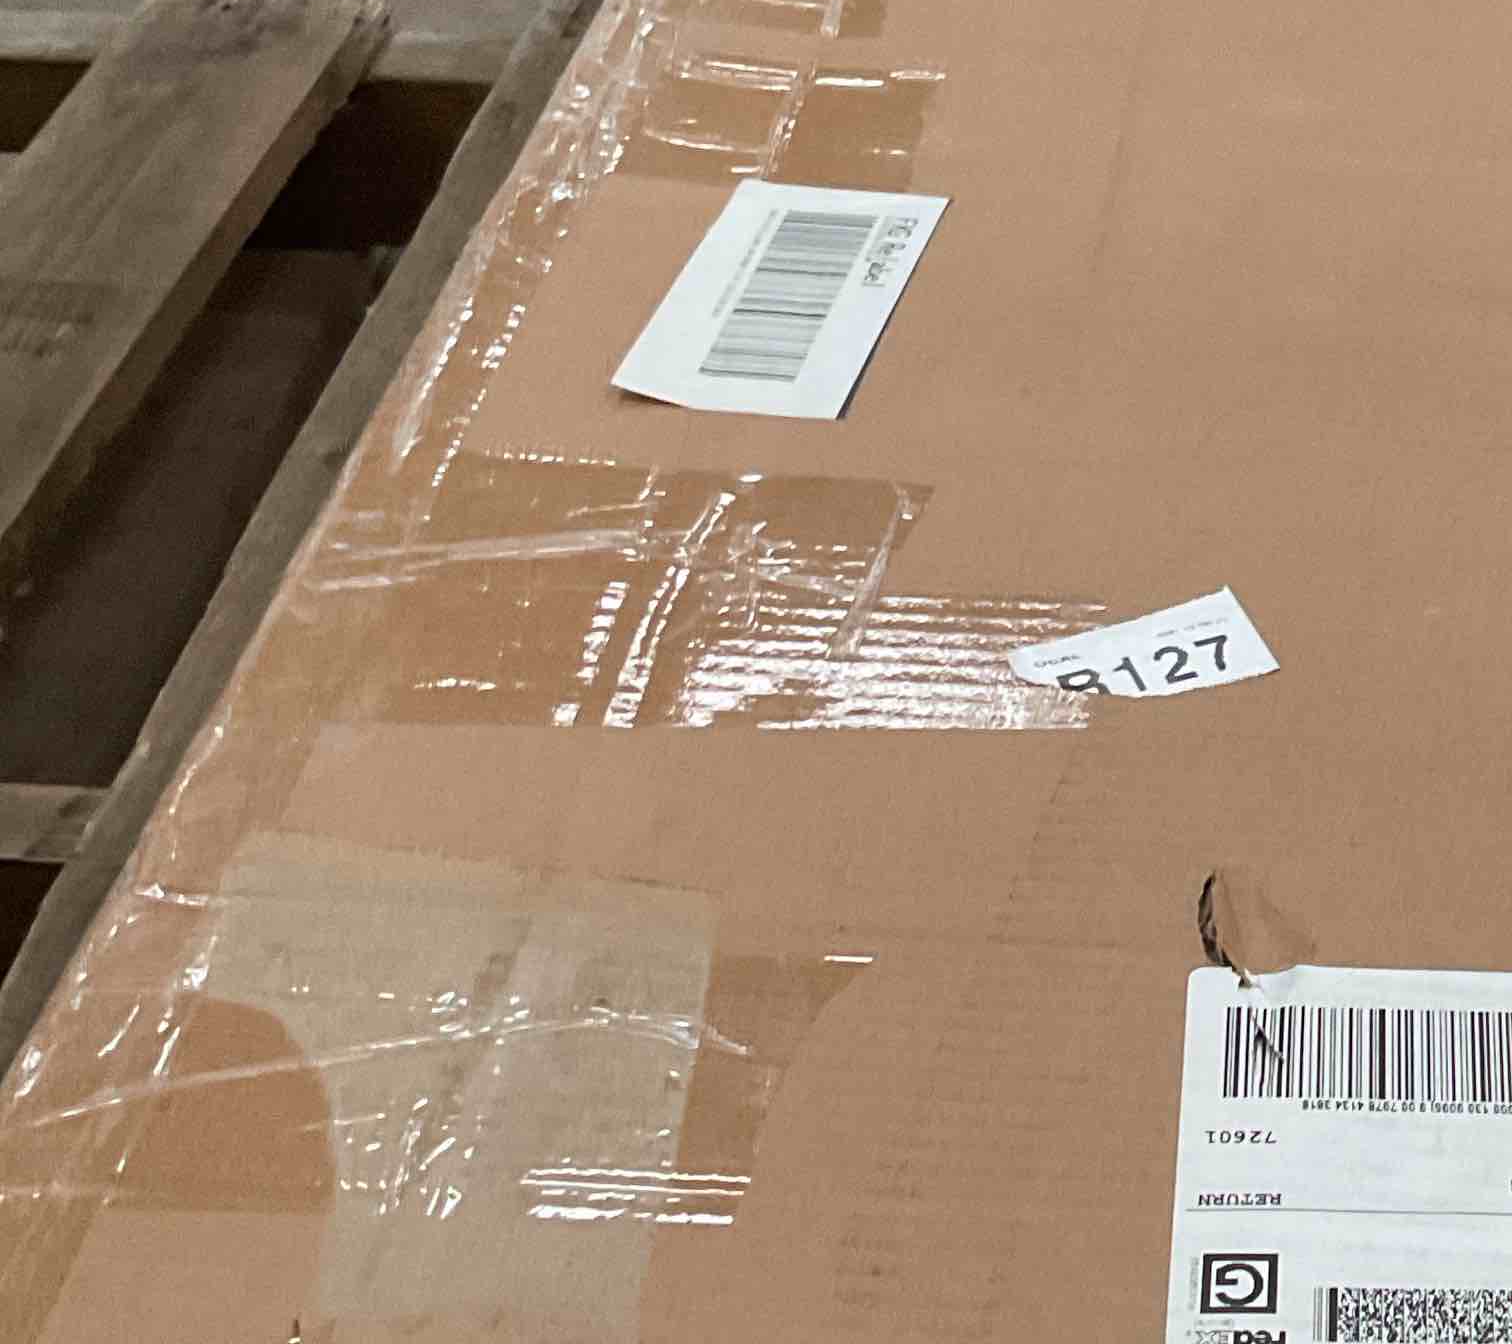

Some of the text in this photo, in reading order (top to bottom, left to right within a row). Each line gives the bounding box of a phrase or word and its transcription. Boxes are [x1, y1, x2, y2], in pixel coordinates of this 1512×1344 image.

[1205, 1130, 1277, 1145] 72601
[1198, 1193, 1282, 1206] RETURN
[1214, 1262, 1265, 1307] G
